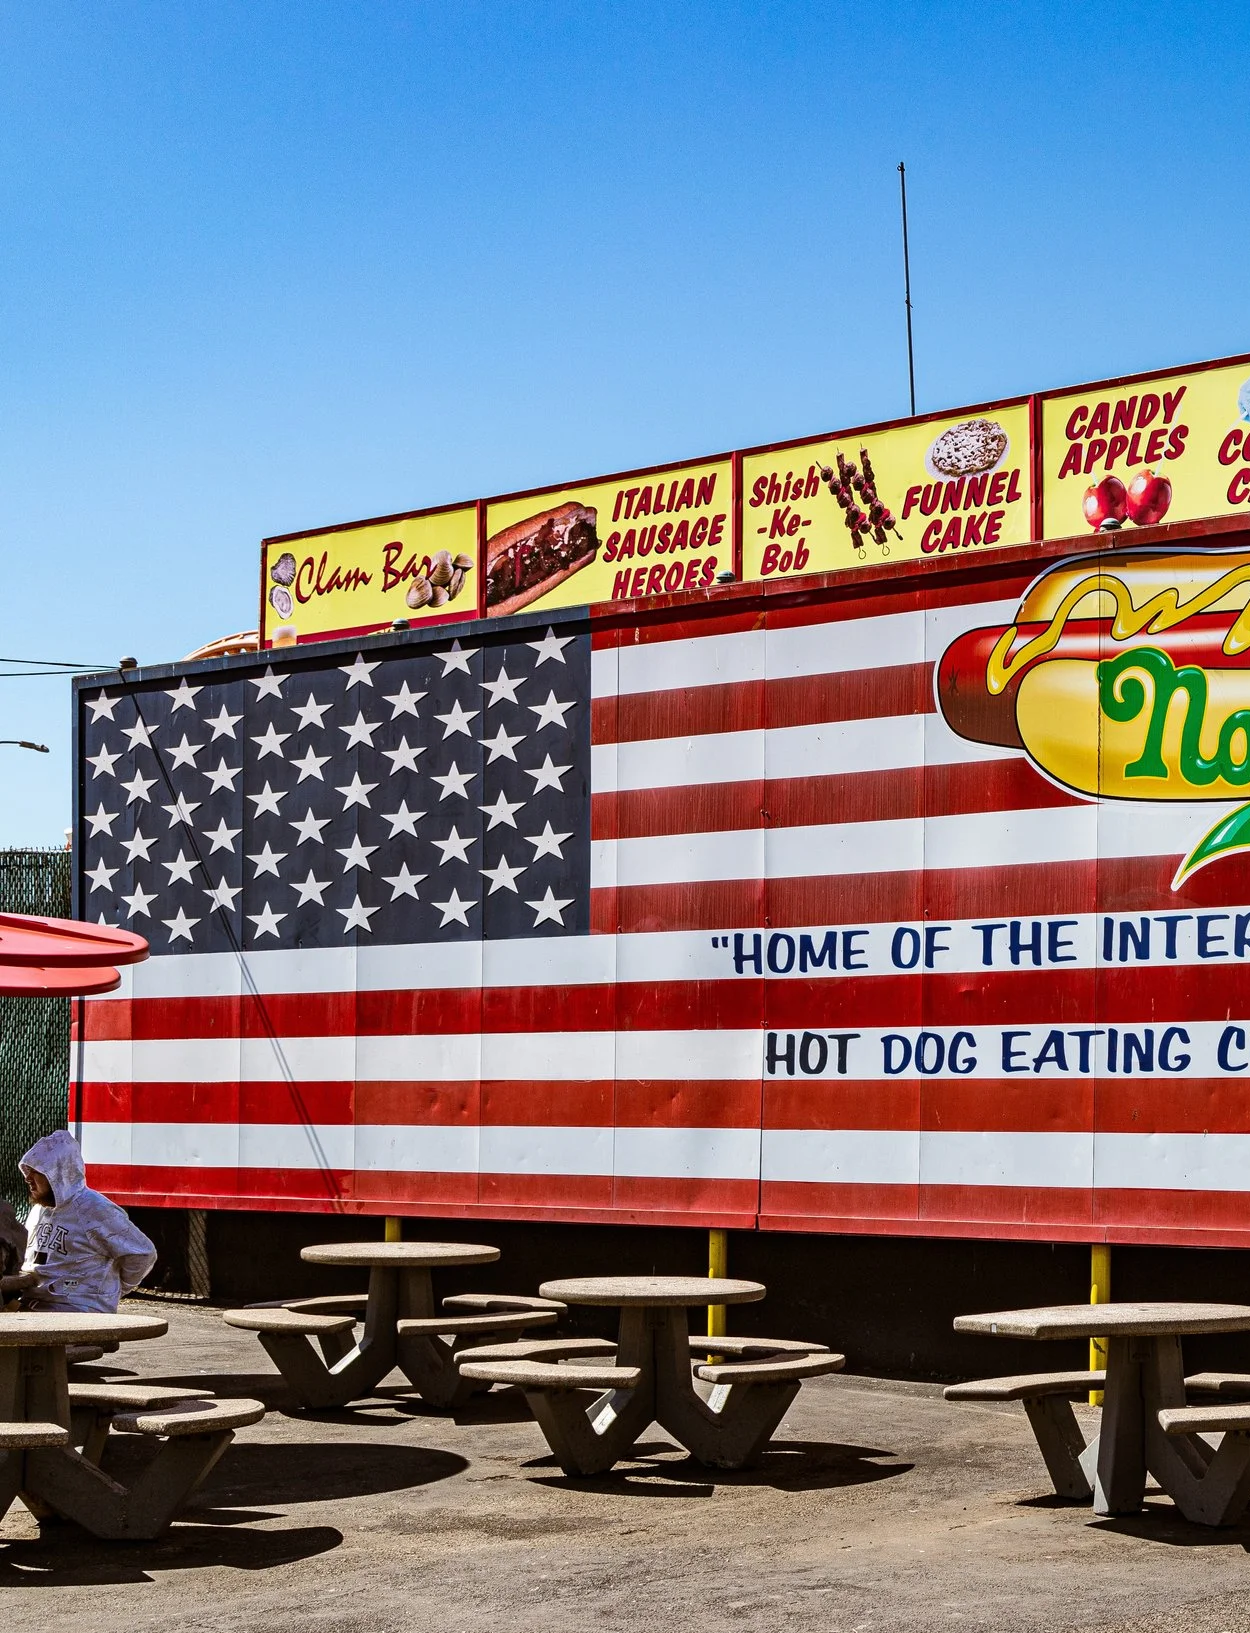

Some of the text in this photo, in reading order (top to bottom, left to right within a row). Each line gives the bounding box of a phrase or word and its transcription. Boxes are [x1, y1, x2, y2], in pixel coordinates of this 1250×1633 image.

[1065, 385, 1187, 441] CANDY
[1058, 424, 1189, 479] APPLES
[611, 472, 717, 522] ITALIAN
[750, 466, 819, 507] Shish
[902, 468, 1021, 519] FUNNEL
[603, 513, 726, 563] SAUSAGE
[757, 506, 812, 540] -Ke-
[921, 510, 1005, 553] CAKE
[295, 540, 436, 604] Clam Bar
[611, 555, 718, 600] HEROES
[760, 538, 809, 576] Bob
[711, 930, 870, 975] "HOME
[891, 926, 952, 969] OF
[971, 920, 1078, 966] THE
[765, 1031, 861, 1075] HOT
[881, 1031, 978, 1074] DOG
[1001, 1027, 1191, 1074] EATING
